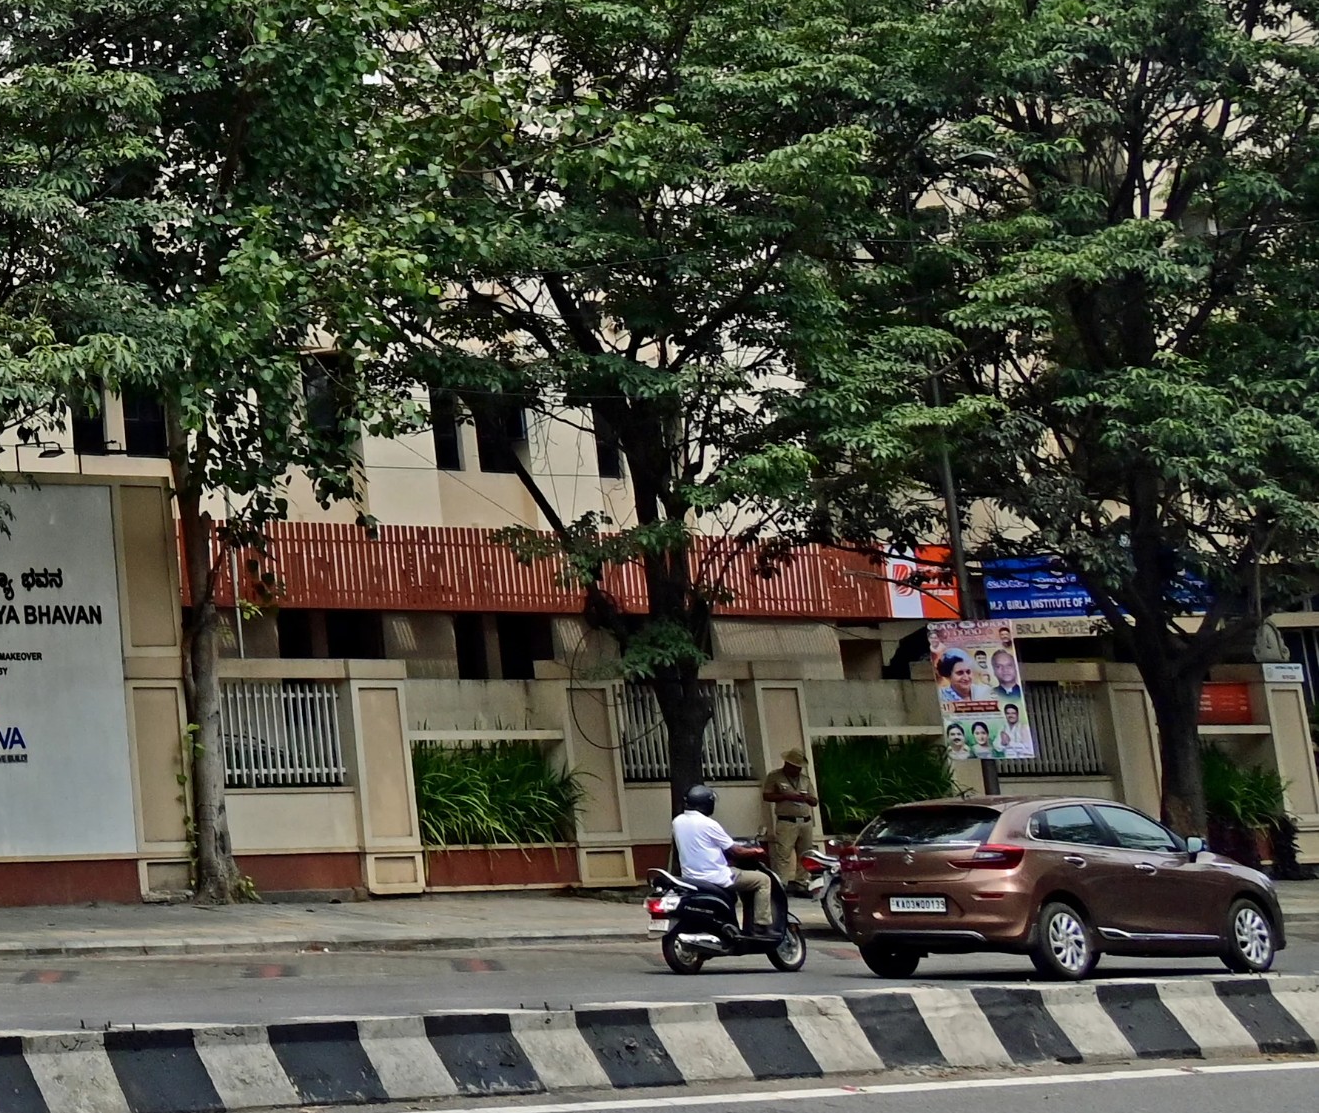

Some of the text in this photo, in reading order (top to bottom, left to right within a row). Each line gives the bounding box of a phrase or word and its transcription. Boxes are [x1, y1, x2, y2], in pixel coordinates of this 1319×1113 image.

[21, 567, 63, 592] ಭವನ
[990, 601, 1005, 611] M.P.
[1007, 599, 1030, 610] BIRLA
[1030, 598, 1072, 609] INSTITUTE
[1073, 597, 1084, 607] OF
[23, 605, 102, 625] BHAVAN
[1016, 623, 1049, 635] BIRLA
[0, 652, 43, 661] MAKEOVER
